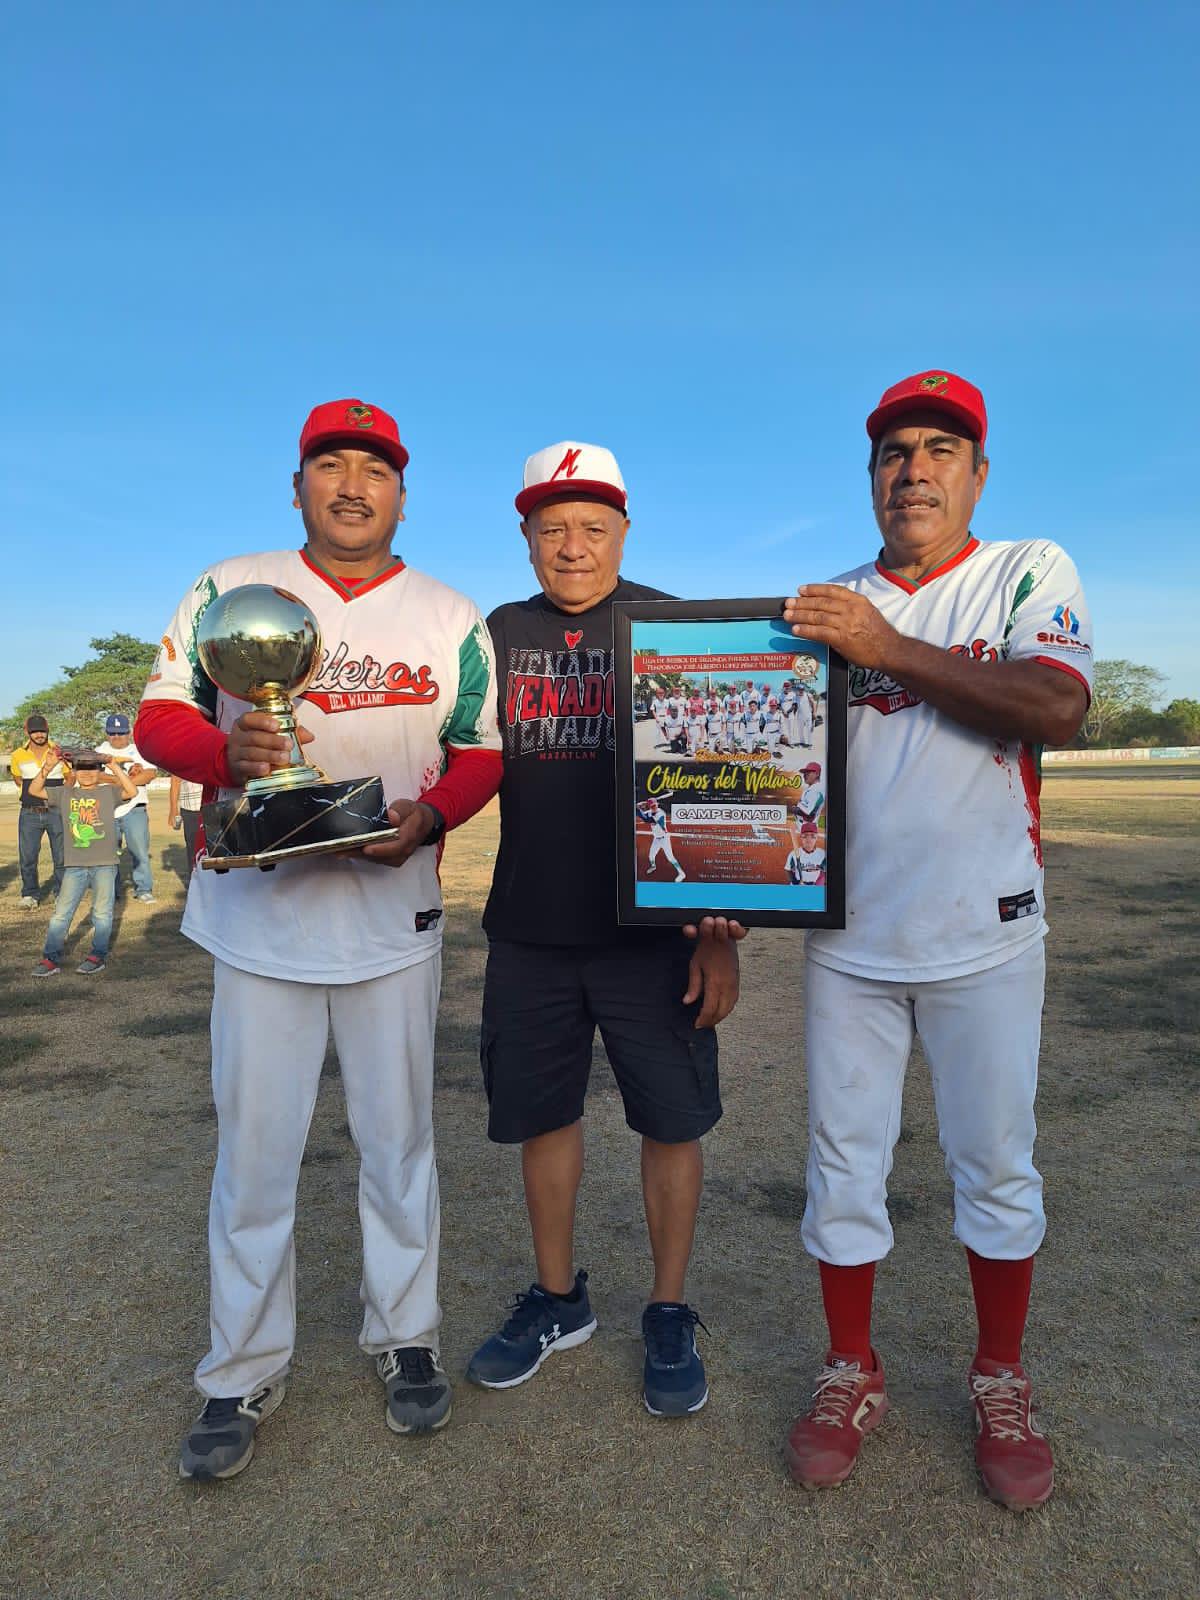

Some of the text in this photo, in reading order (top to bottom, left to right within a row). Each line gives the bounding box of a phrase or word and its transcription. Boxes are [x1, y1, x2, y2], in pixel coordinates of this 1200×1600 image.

[328, 693, 385, 709] DEL WALAMO
[646, 763, 802, 794] Chileros del Walamo
[70, 798, 97, 812] FEAR
[675, 808, 782, 822] CAMPEONATO
